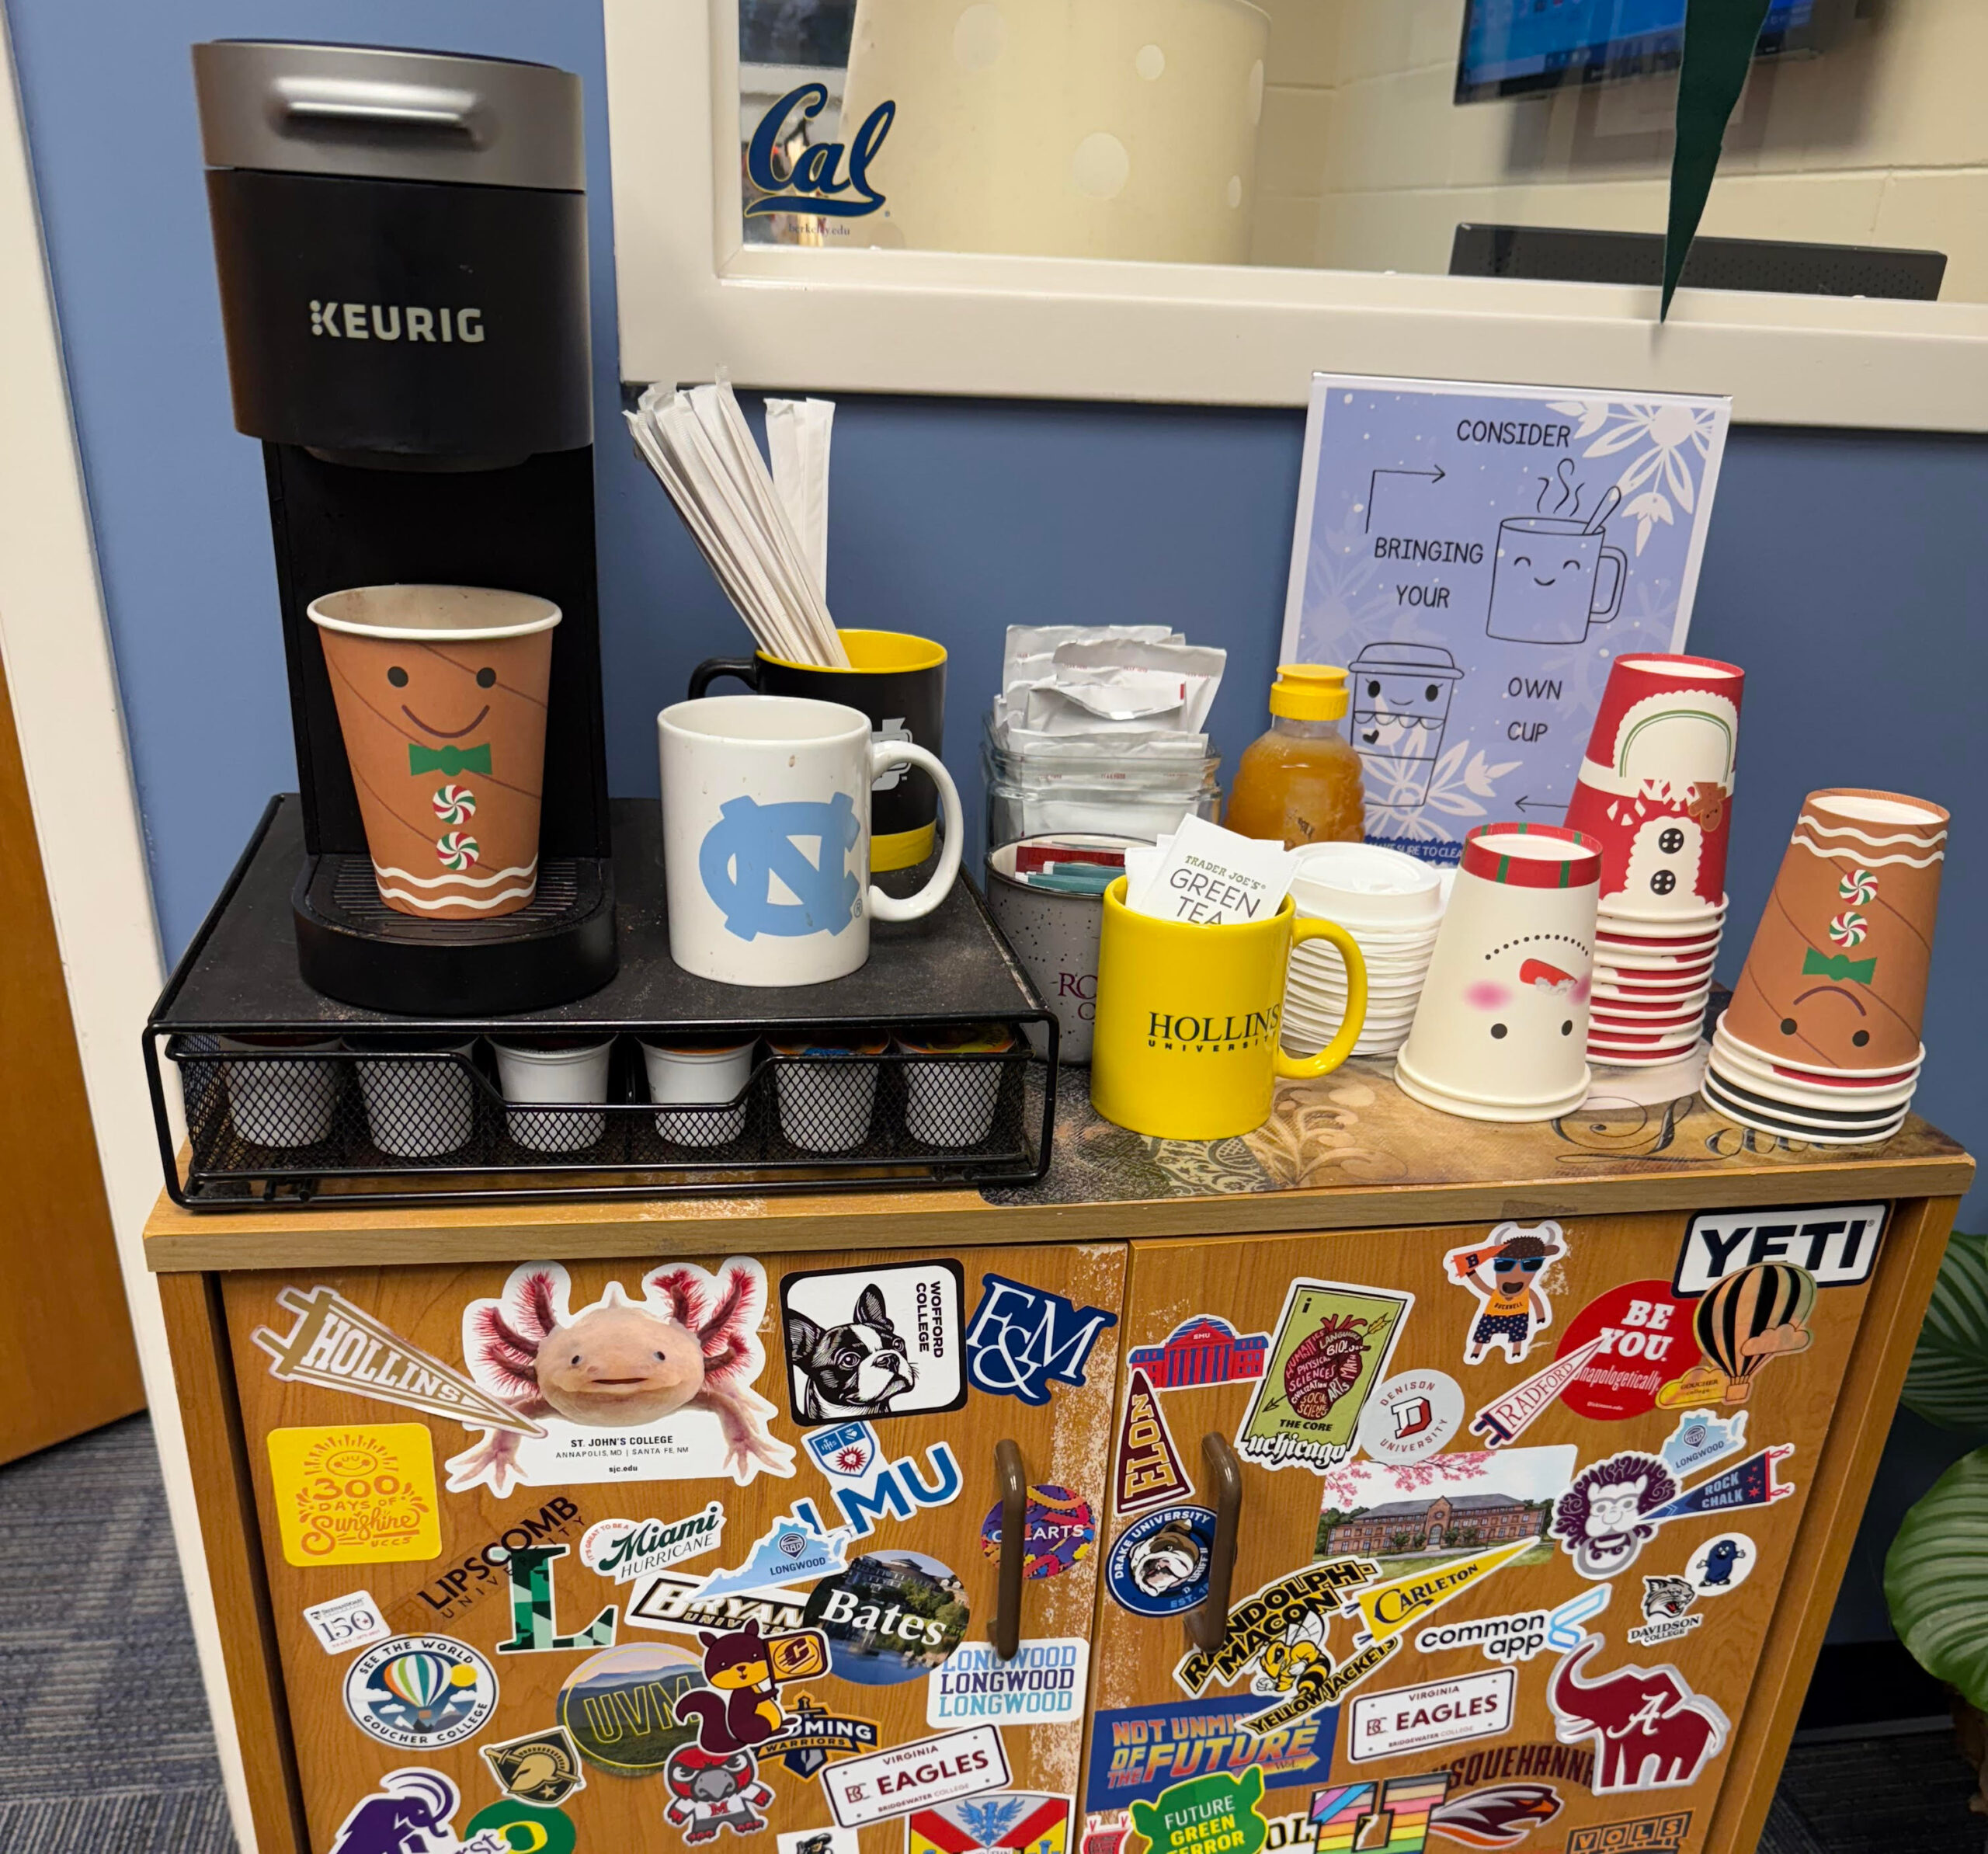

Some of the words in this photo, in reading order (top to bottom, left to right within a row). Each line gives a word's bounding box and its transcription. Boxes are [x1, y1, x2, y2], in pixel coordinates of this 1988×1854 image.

[746, 82, 896, 217] Cal
[310, 300, 485, 343] KEURIG
[1457, 419, 1571, 447] CONSIDER
[1374, 537, 1484, 565] BRINGING
[1396, 584, 1451, 609] YOUR
[1507, 677, 1562, 701] OWN
[1507, 721, 1548, 743] CUP
[1396, 844, 1420, 856] SURE
[1423, 847, 1437, 857] TO
[1184, 855, 1228, 877] TRADER
[1170, 868, 1261, 919] GREEN
[1176, 896, 1224, 925] TEA
[1149, 1004, 1281, 1042] HOLLINS
[1149, 1035, 1274, 1052] UNIVERSIT
[1465, 1254, 1479, 1268] B
[1700, 1220, 1867, 1278] YETI
[915, 1282, 930, 1353] COLLEGE
[930, 1280, 944, 1358] WOFFORD
[1621, 1299, 1675, 1330] BE
[966, 1282, 1106, 1399] F&M
[301, 1311, 462, 1403] HOLLINS
[1288, 1364, 1336, 1392] SCIENCES
[1327, 1376, 1350, 1402] ARTS
[1379, 1380, 1437, 1407] DENISON
[1496, 1362, 1573, 1428] RADFORD
[1280, 1418, 1301, 1429] THE
[1302, 1421, 1333, 1432] CORE
[1391, 1397, 1433, 1440] D
[571, 1439, 585, 1448] ST.
[589, 1438, 626, 1447] JOHN'S
[630, 1435, 673, 1445] COLLEGE
[1124, 1393, 1178, 1500] ELON
[1379, 1417, 1448, 1453] UNIVERSITY
[610, 1449, 622, 1457] MD
[1675, 1440, 1725, 1469] LONGWOOD
[609, 1465, 638, 1474] sjc.edu
[1705, 1471, 1740, 1496] ROCK
[313, 1475, 400, 1501] 300
[796, 1446, 959, 1537] LMU
[1701, 1488, 1743, 1509] CHALK
[318, 1501, 370, 1511] DAYS
[378, 1497, 397, 1507] OF
[301, 1507, 420, 1556] Sunshine
[371, 1536, 412, 1548] UCCS
[599, 1506, 719, 1571] Miami
[992, 1525, 1084, 1543] CARTS
[1114, 1539, 1134, 1580] DRAKE
[1131, 1511, 1211, 1539] UNIVERSITY
[417, 1496, 579, 1612] LIPSCOMB
[621, 1532, 713, 1578] HURRICANE
[770, 1556, 826, 1577] LONGWOOD
[1170, 1595, 1197, 1609] EST.
[1374, 1564, 1479, 1624] CARLETON
[320, 1610, 374, 1642] 150
[818, 1588, 947, 1647] Bates
[1420, 1615, 1545, 1647] common
[1631, 1616, 1700, 1640] DAVIDSON
[1217, 1588, 1342, 1682] MACON
[1489, 1633, 1543, 1659] app
[1644, 1629, 1685, 1643] COLLEGE
[360, 1656, 380, 1675] SEE
[383, 1641, 412, 1655] THE
[421, 1640, 474, 1664] WORLD
[942, 1645, 1077, 1671] LONWOOD
[940, 1668, 1074, 1695] LONGWOOD
[1409, 1685, 1460, 1702] VIRGINIA
[938, 1691, 1072, 1717] LONGWOOD
[1246, 1687, 1326, 1735] YELLOW
[1396, 1694, 1497, 1731] EAGLES
[363, 1714, 429, 1744] GOUCHER
[436, 1703, 488, 1742] COLLEGE
[1112, 1720, 1166, 1747] NOT
[1388, 1733, 1439, 1748] BRIDGEWATER
[1441, 1726, 1473, 1737] COLLEGE
[766, 1737, 845, 1752] WARRIORS
[882, 1744, 938, 1765] VIRGINIA
[1111, 1746, 1145, 1771] OF
[1144, 1726, 1319, 1783] FUTURE
[877, 1749, 989, 1796] EAGLES
[1107, 1766, 1144, 1790] THE
[708, 1800, 729, 1816] M
[878, 1792, 932, 1814] BRIDGEWATER
[934, 1783, 970, 1798] COLLEGE
[1165, 1794, 1236, 1830] FUTURE
[1170, 1814, 1236, 1847] GREEN
[1579, 1820, 1679, 1849] VOLS
